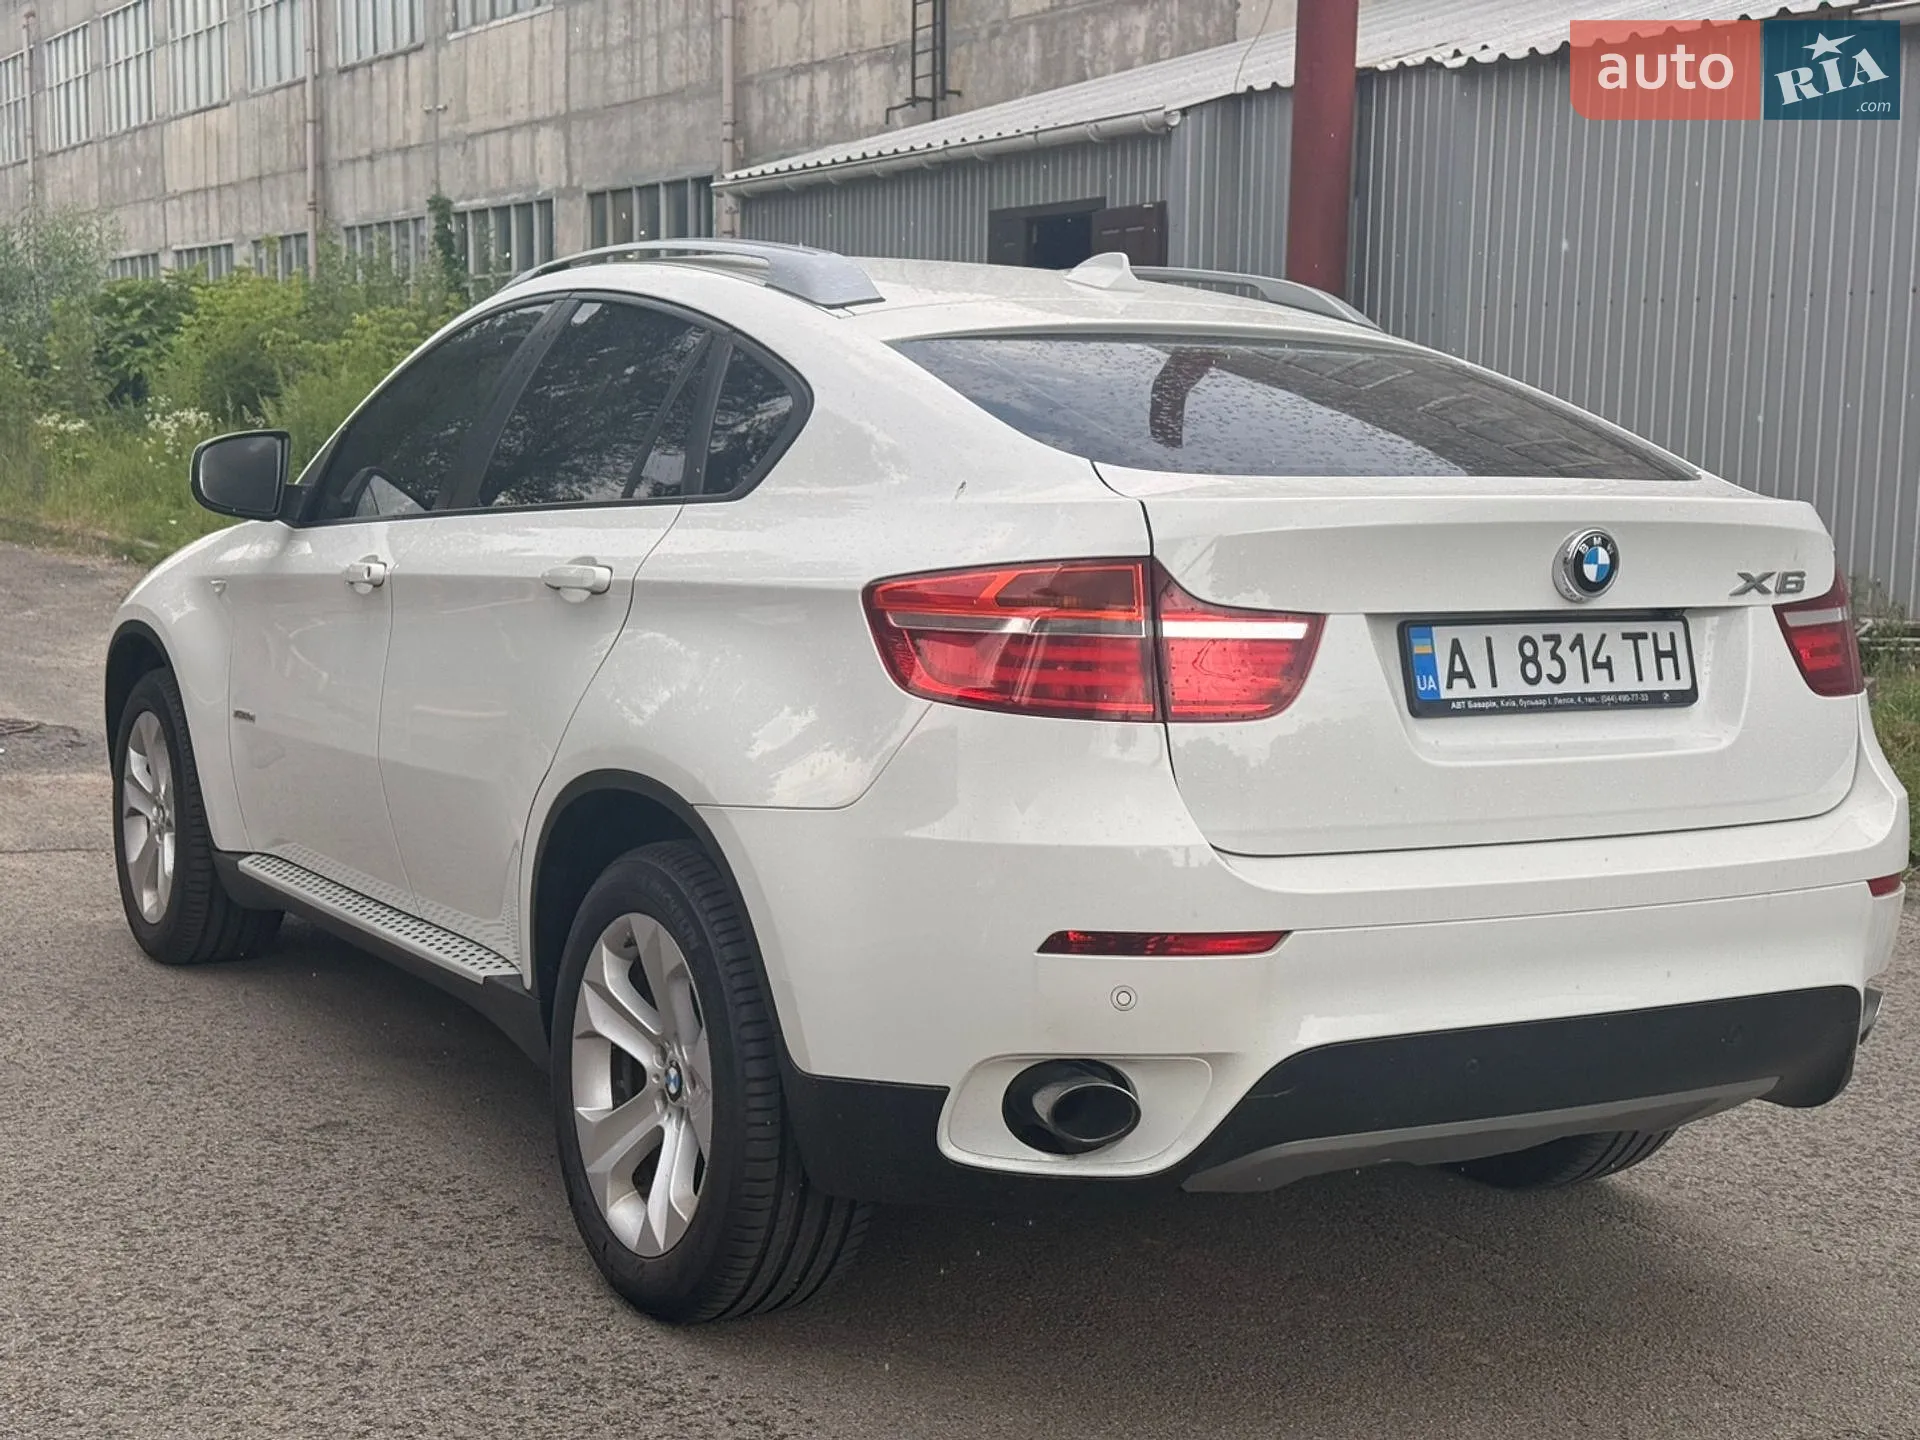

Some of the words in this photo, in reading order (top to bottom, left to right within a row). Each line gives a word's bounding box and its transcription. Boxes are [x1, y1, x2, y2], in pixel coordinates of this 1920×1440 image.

[1729, 570, 1806, 597] X6
[1446, 635, 1499, 690] AI
[1518, 632, 1615, 686] 8314
[1621, 631, 1681, 683] TH
[1416, 674, 1437, 691] UA
